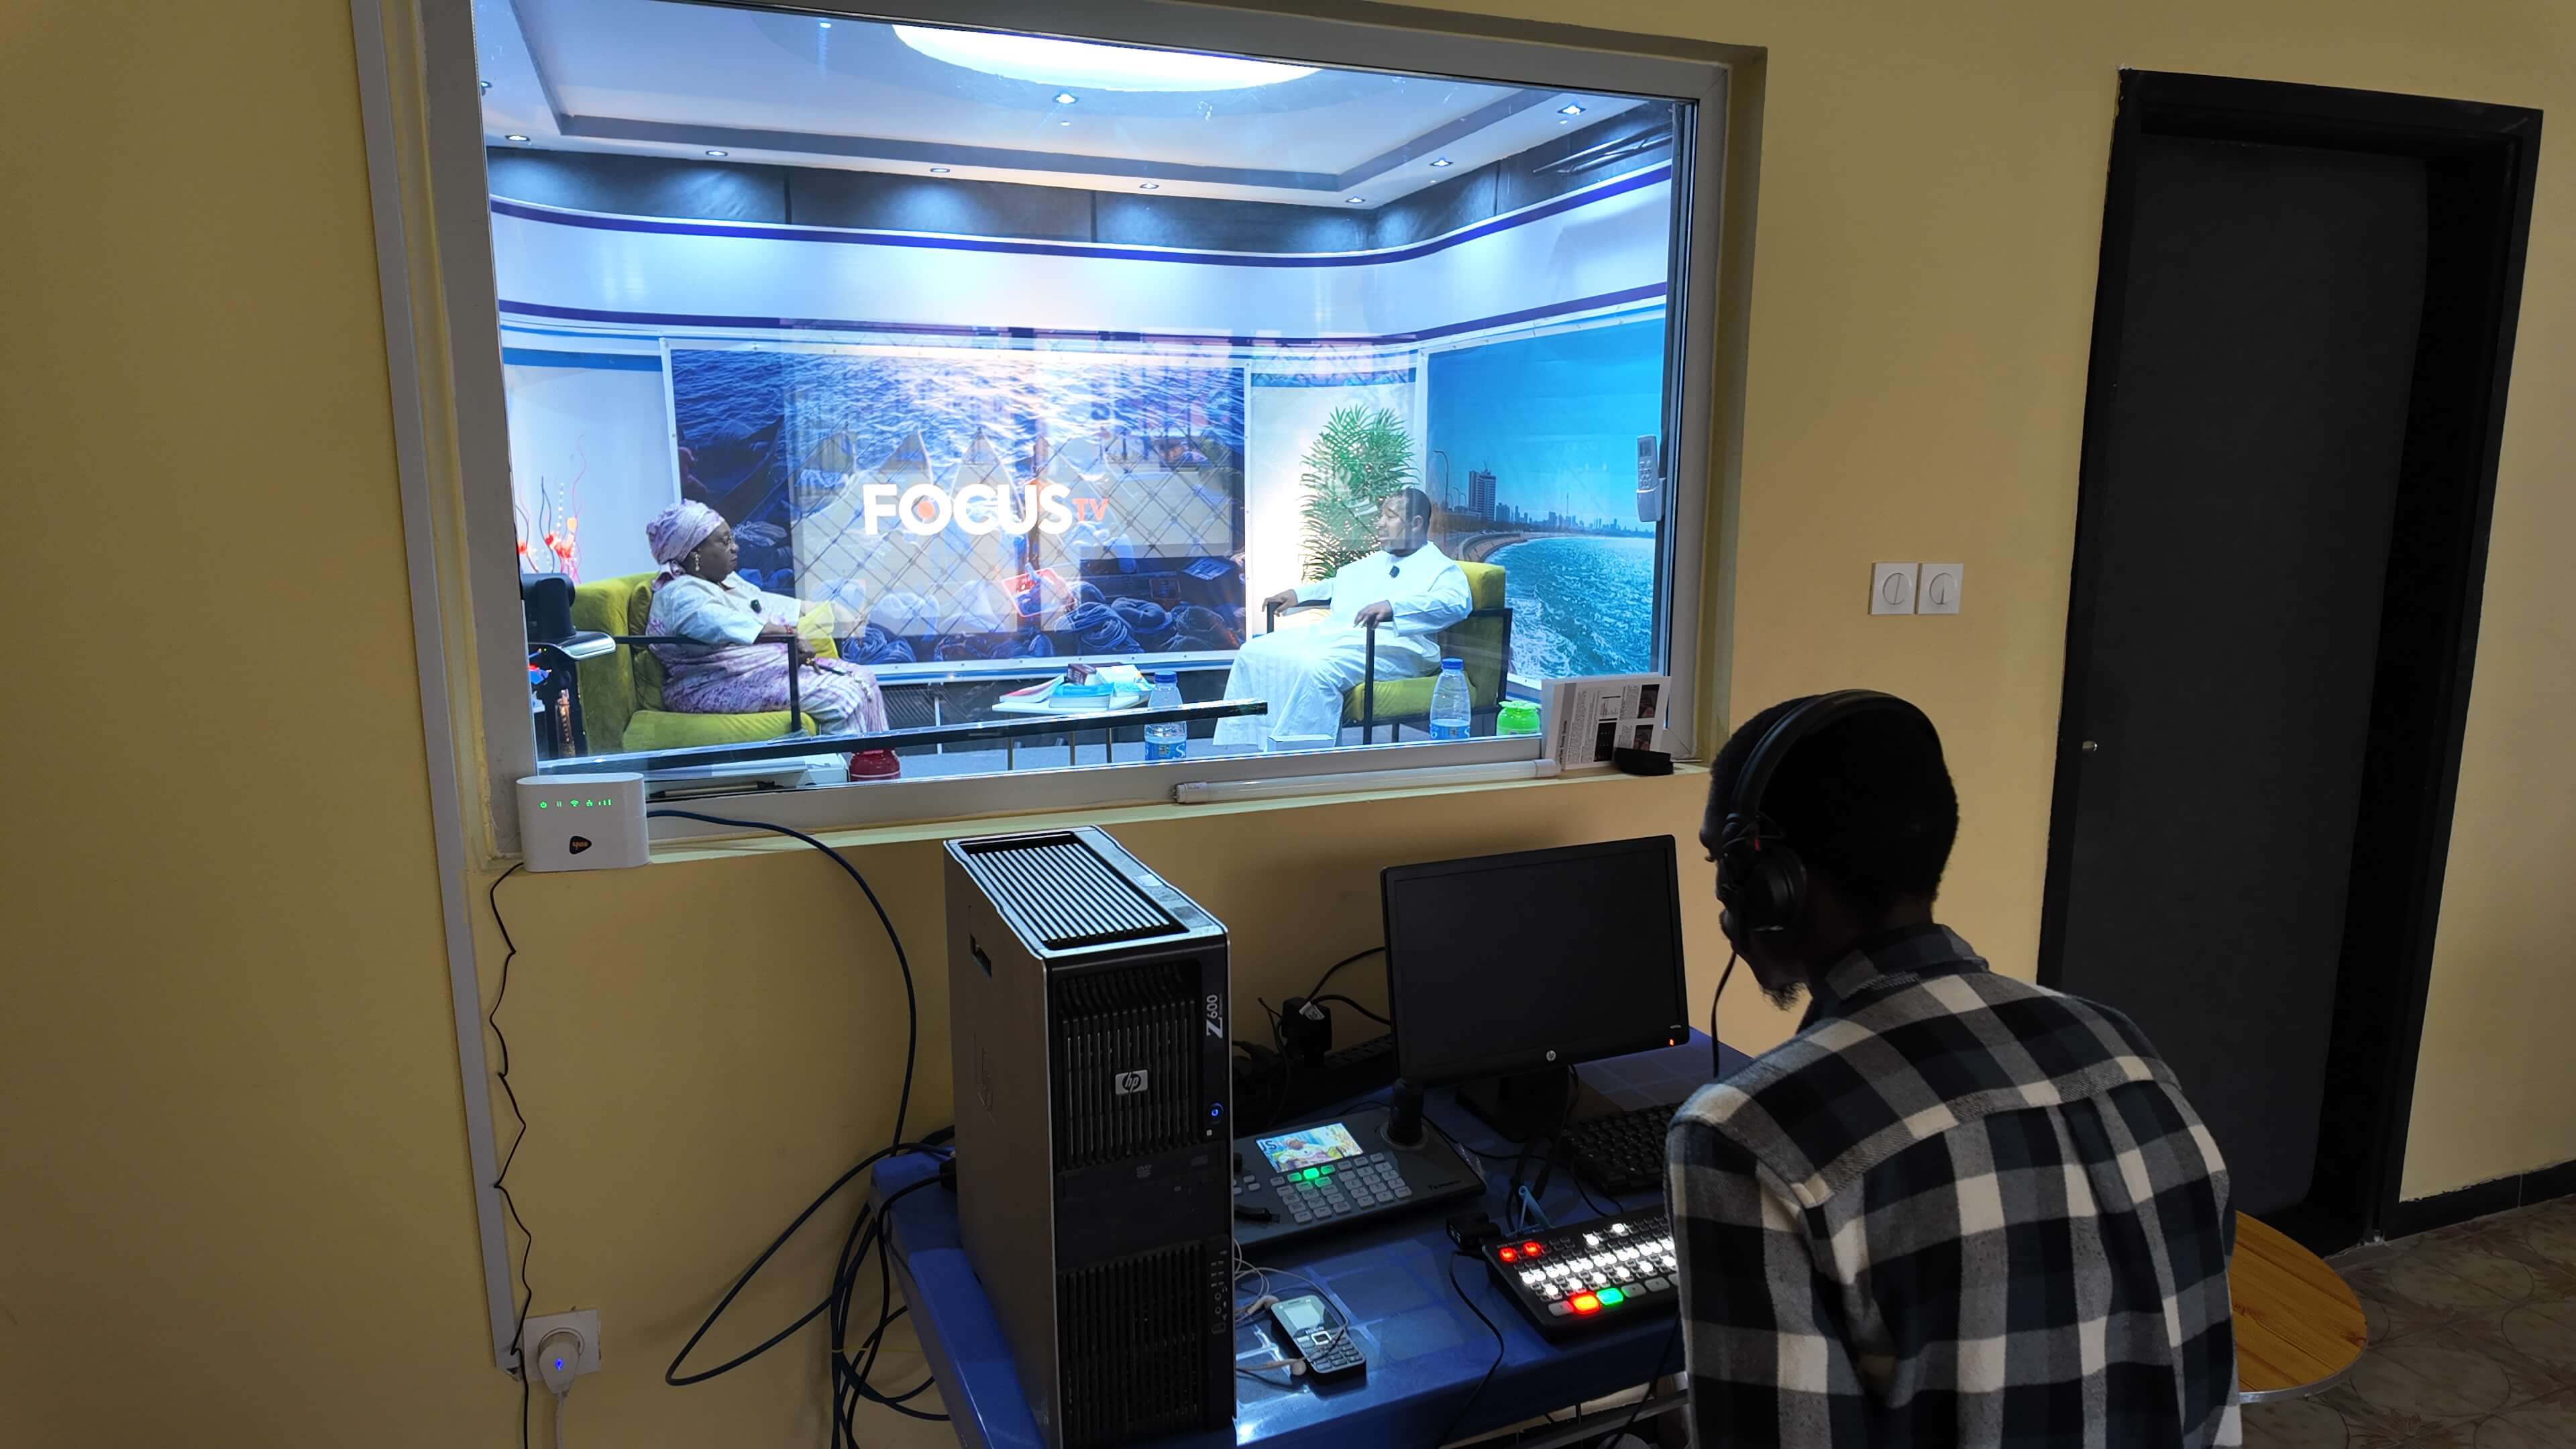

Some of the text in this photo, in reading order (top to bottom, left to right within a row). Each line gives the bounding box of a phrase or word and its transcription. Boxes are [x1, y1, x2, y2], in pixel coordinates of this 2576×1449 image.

[863, 484, 1109, 536] FOCUS TV
[1206, 995, 1223, 1038] Z600
